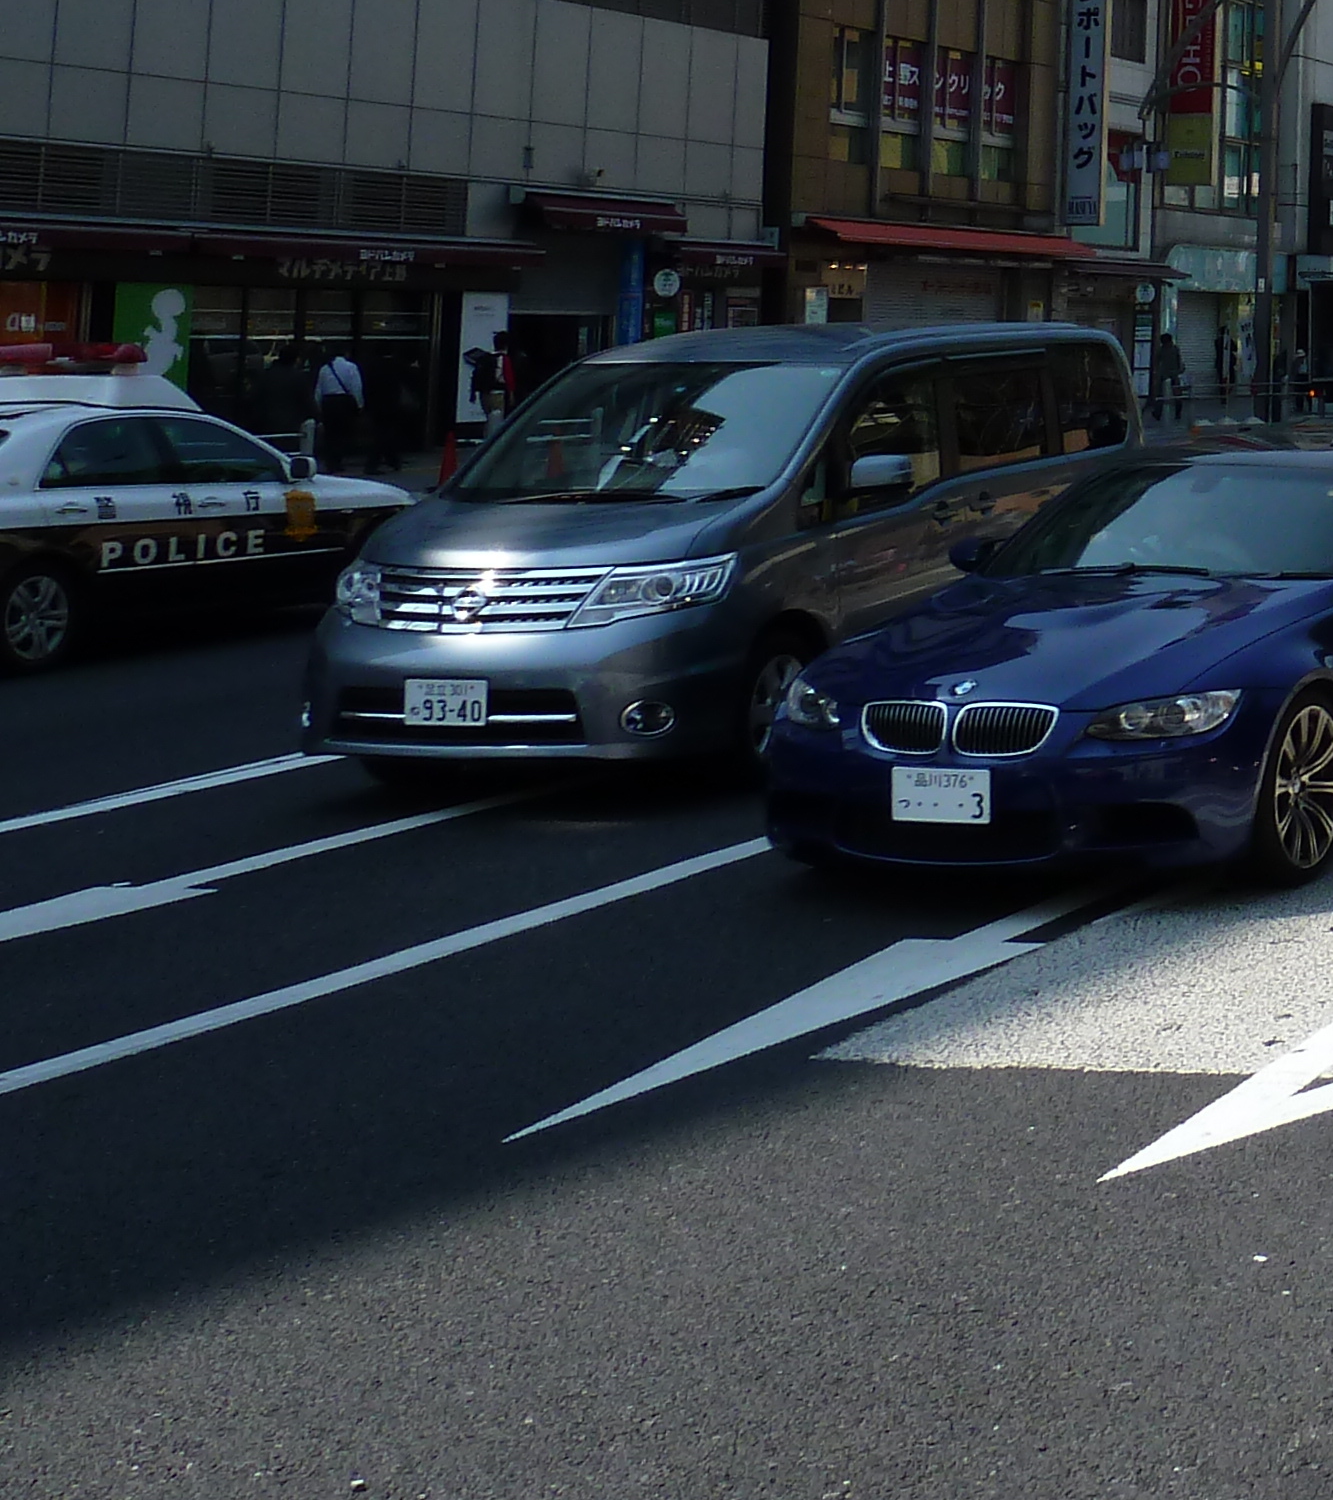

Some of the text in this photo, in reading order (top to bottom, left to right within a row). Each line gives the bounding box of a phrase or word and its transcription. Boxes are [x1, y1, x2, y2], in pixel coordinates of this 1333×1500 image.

[0, 249, 51, 272] メラ
[101, 529, 266, 568] POLICE
[423, 699, 482, 723] 93-40
[914, 772, 968, 789] 品川 376
